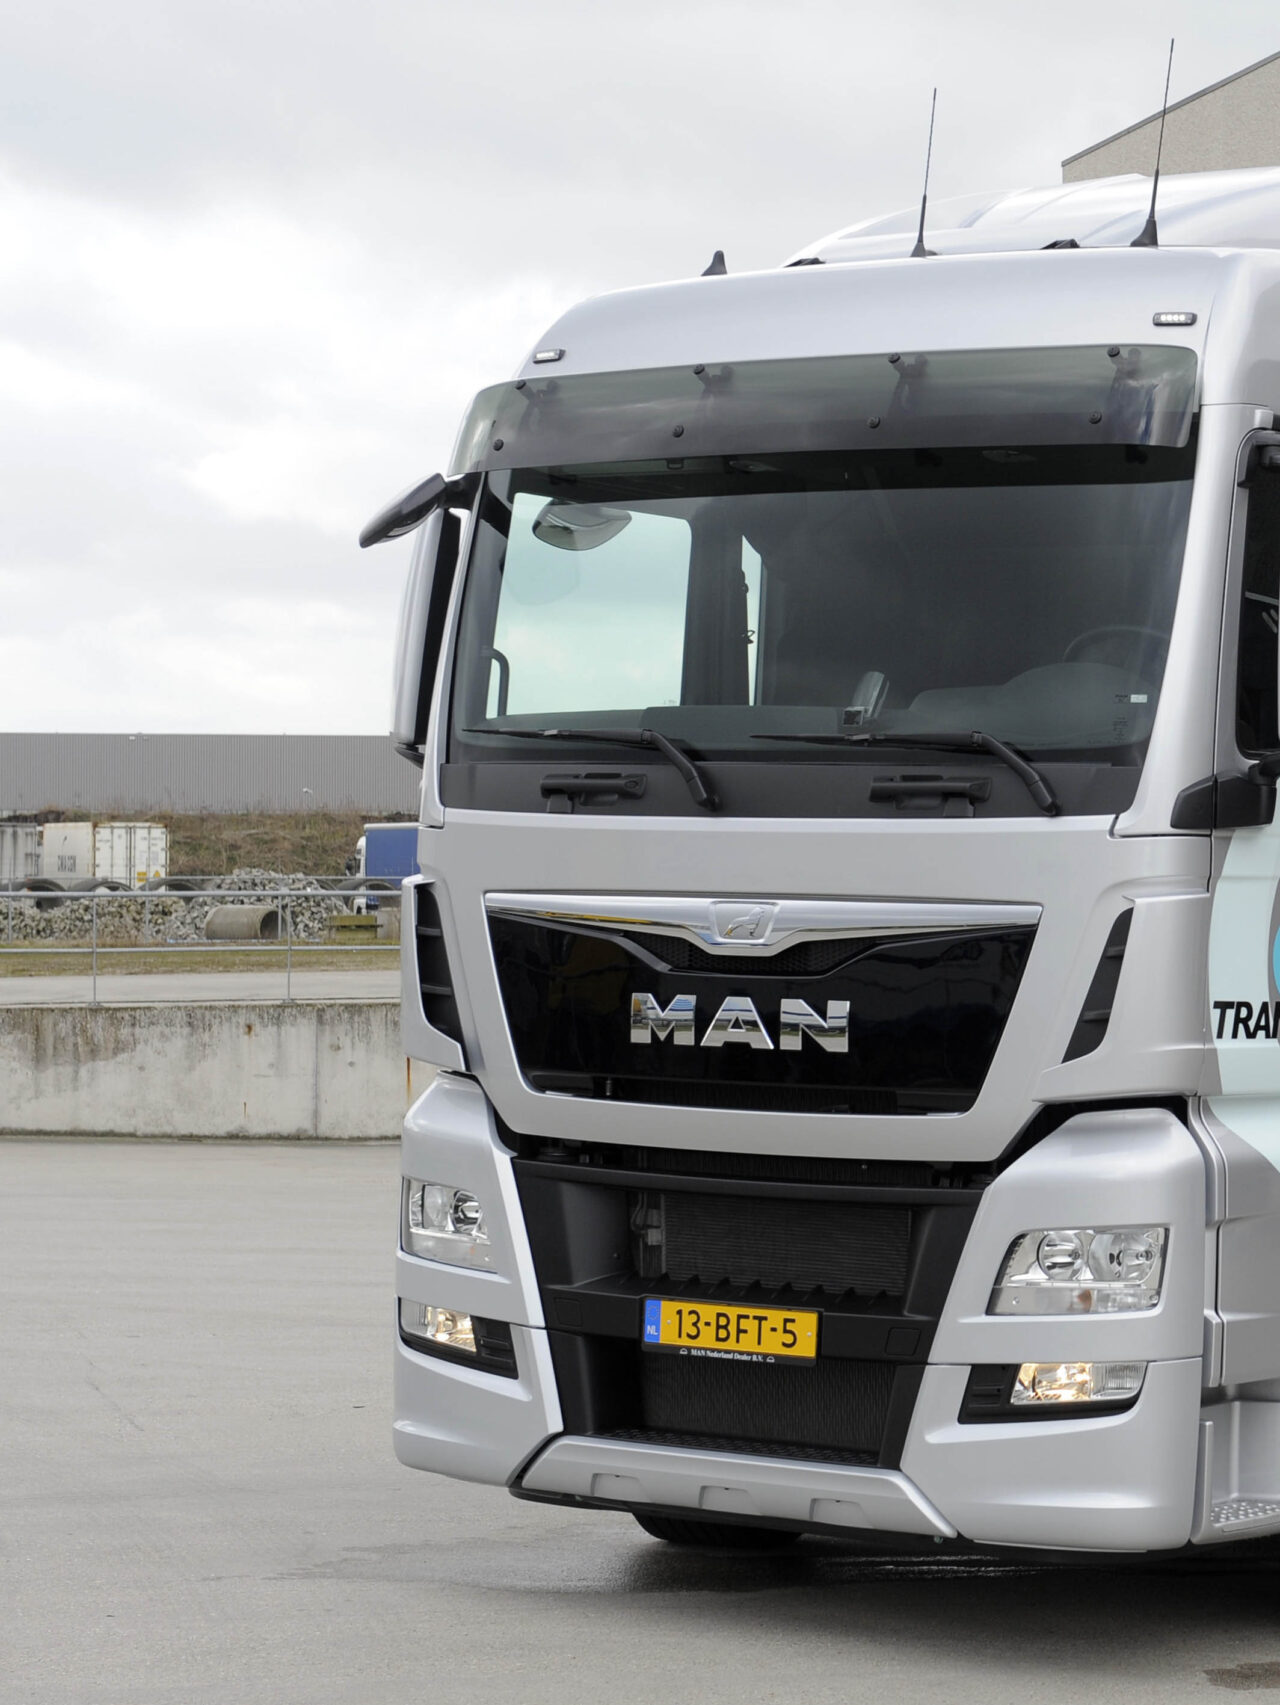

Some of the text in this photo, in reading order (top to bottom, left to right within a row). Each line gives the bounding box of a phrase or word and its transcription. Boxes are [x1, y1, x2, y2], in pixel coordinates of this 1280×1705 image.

[630, 992, 850, 1053] MAN
[647, 1325, 658, 1336] NL
[676, 1308, 798, 1349] 13-BFT-5
[691, 1348, 706, 1356] MAN
[706, 1350, 733, 1359] Nederland
[734, 1352, 752, 1361] Dealer
